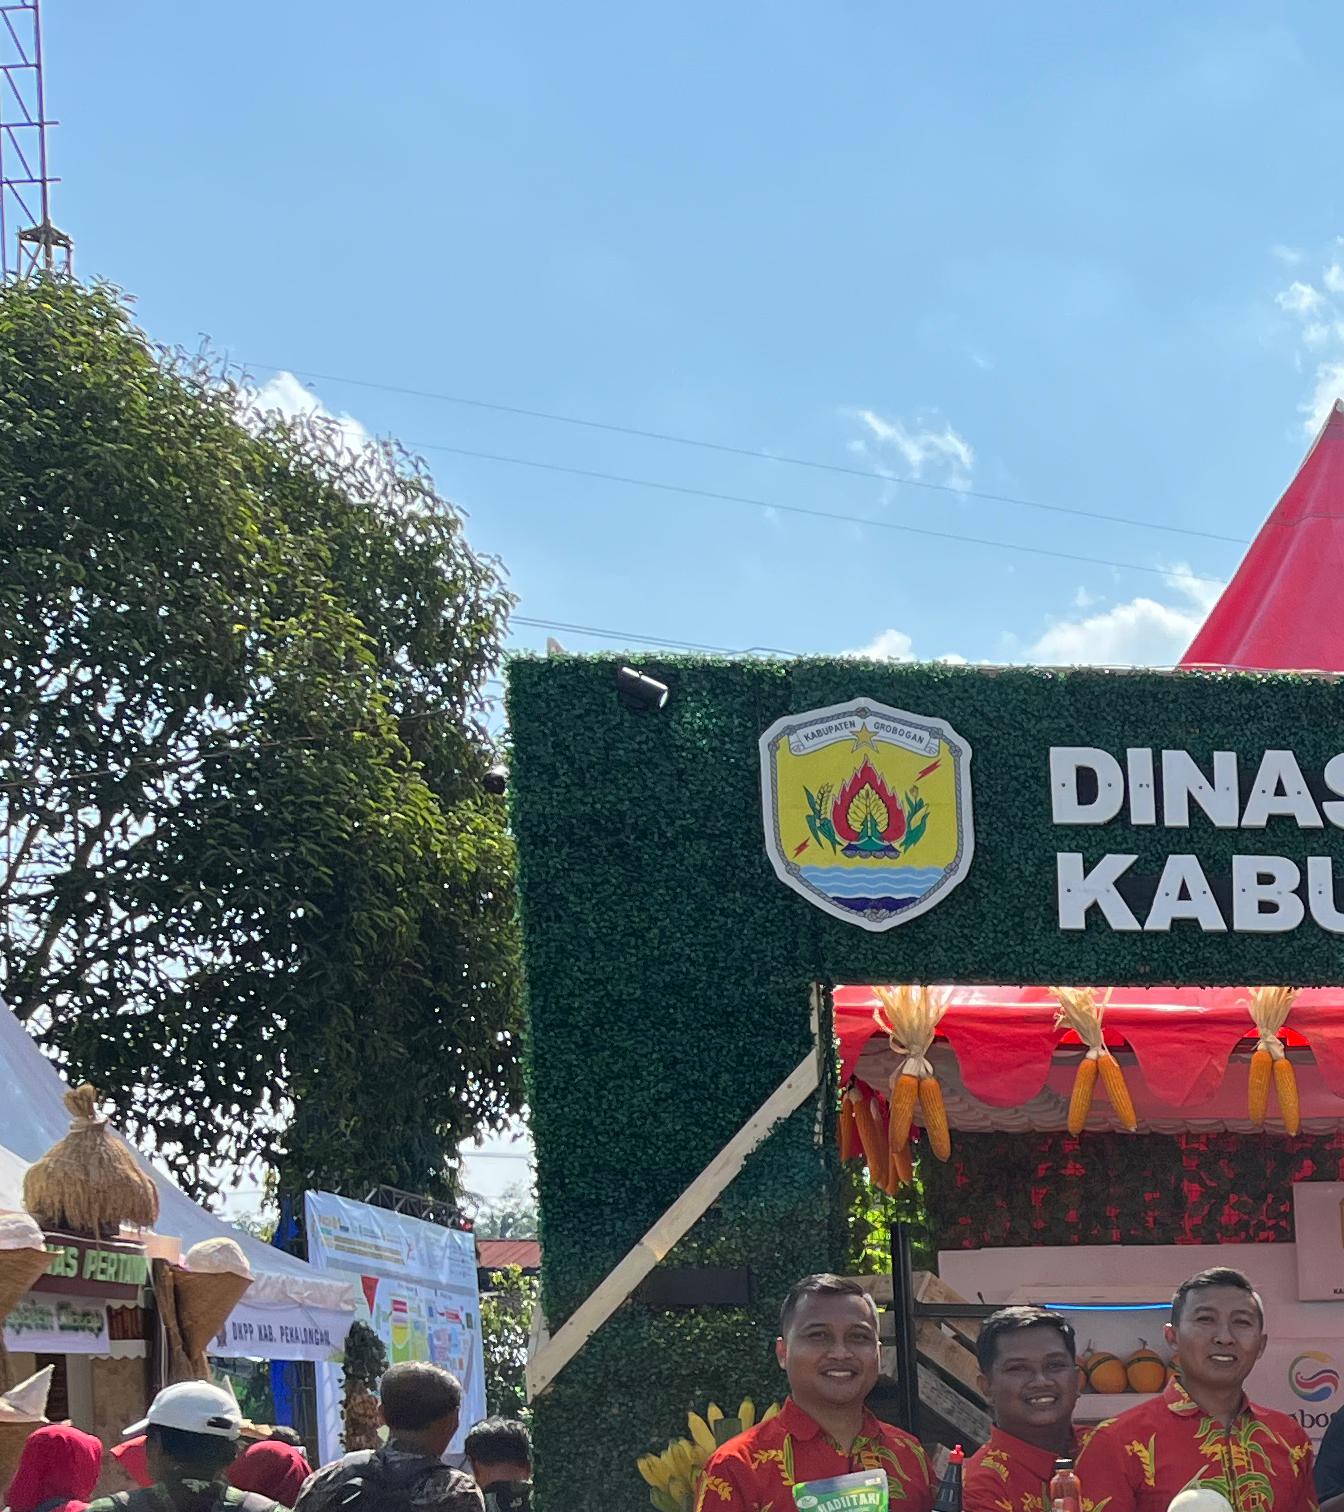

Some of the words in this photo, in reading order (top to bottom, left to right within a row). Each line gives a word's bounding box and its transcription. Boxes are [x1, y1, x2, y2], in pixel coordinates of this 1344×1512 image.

[804, 720, 856, 742] KABUPATEN
[873, 721, 925, 744] GROBOGAN
[257, 1324, 276, 1342] KAB.
[280, 1326, 331, 1346] PEKALONGAN
